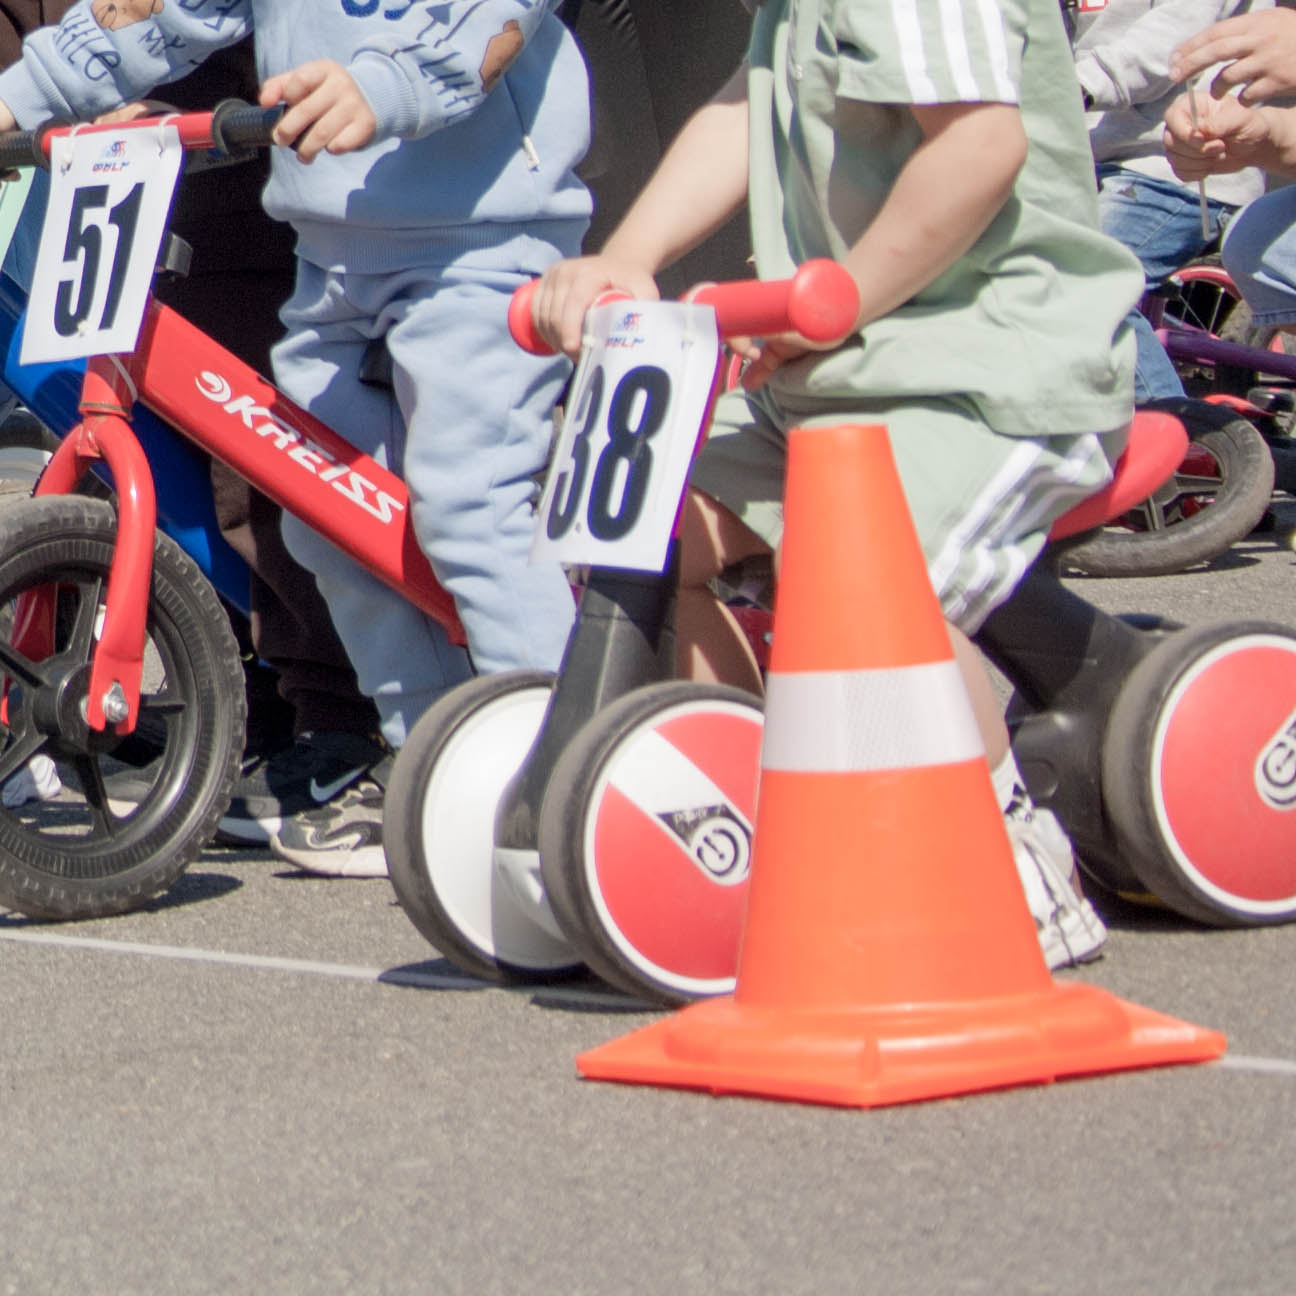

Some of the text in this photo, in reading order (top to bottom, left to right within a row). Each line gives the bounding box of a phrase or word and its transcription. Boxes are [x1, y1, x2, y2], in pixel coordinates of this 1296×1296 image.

[53, 181, 145, 338] 51
[223, 394, 405, 524] KREISS
[546, 365, 672, 543] 38
